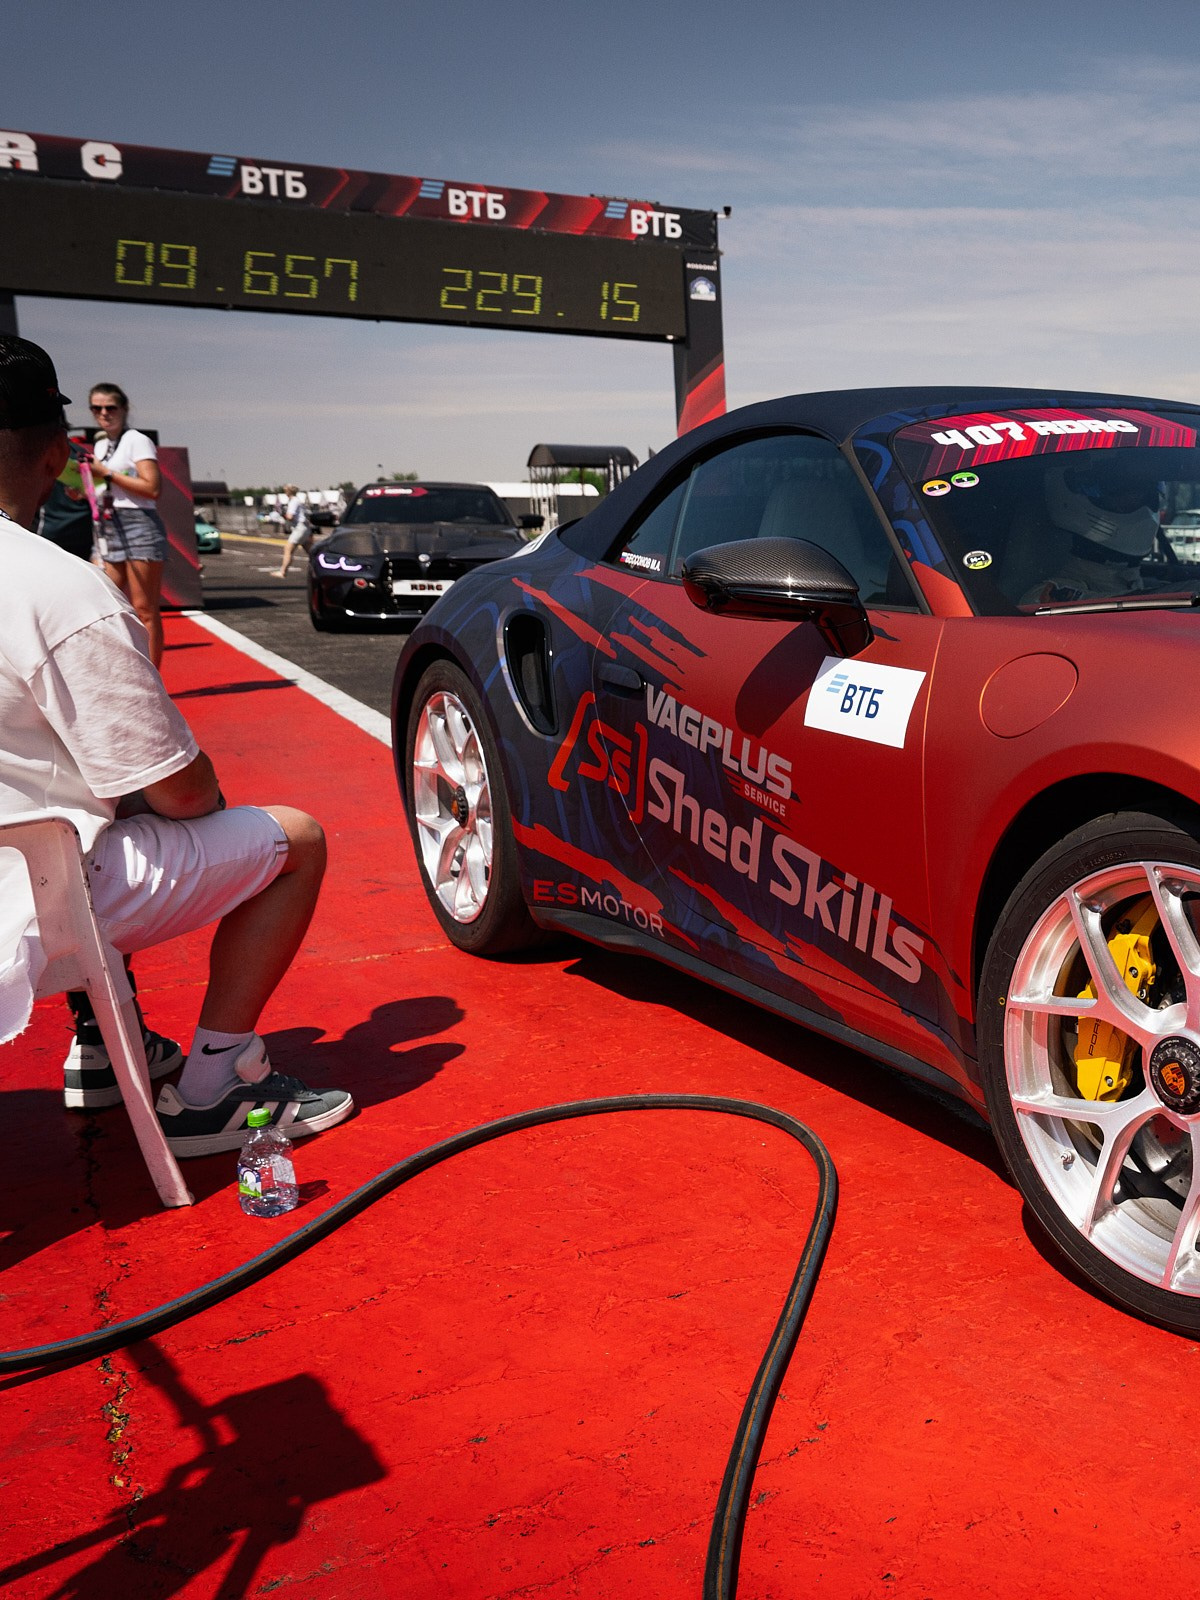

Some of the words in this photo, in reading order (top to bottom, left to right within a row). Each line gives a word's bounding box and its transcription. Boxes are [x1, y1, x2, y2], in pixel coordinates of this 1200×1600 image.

[240, 165, 307, 199] ВТБ
[448, 188, 506, 220] ВТБ
[630, 208, 683, 239] ВТБ
[930, 422, 1027, 450] 407
[410, 583, 443, 591] RDRC
[840, 683, 884, 719] ВТБ
[644, 682, 793, 801] VAGPLUS
[744, 783, 787, 817] SERVICE
[648, 757, 763, 884] Shed
[769, 833, 926, 984] Skills
